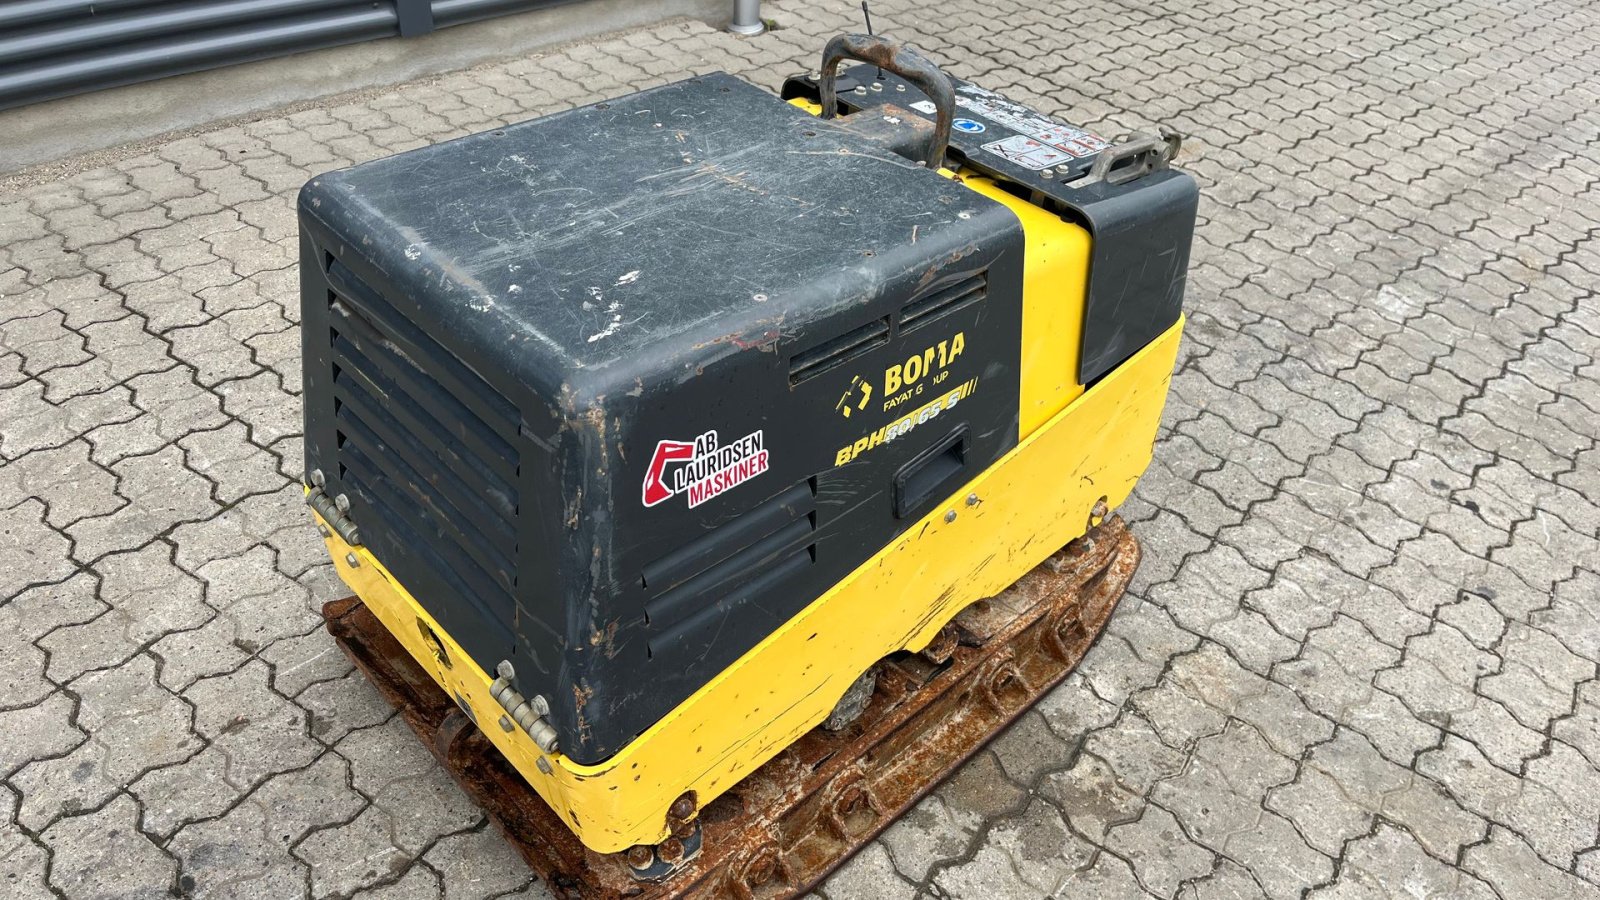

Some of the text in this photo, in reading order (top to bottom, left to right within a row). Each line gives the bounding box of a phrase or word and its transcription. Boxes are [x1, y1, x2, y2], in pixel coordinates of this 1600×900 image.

[883, 388, 914, 412] FAYAT
[676, 432, 761, 491] LAURIDSEN
[696, 432, 716, 460] AB
[689, 451, 768, 506] MASKINER
